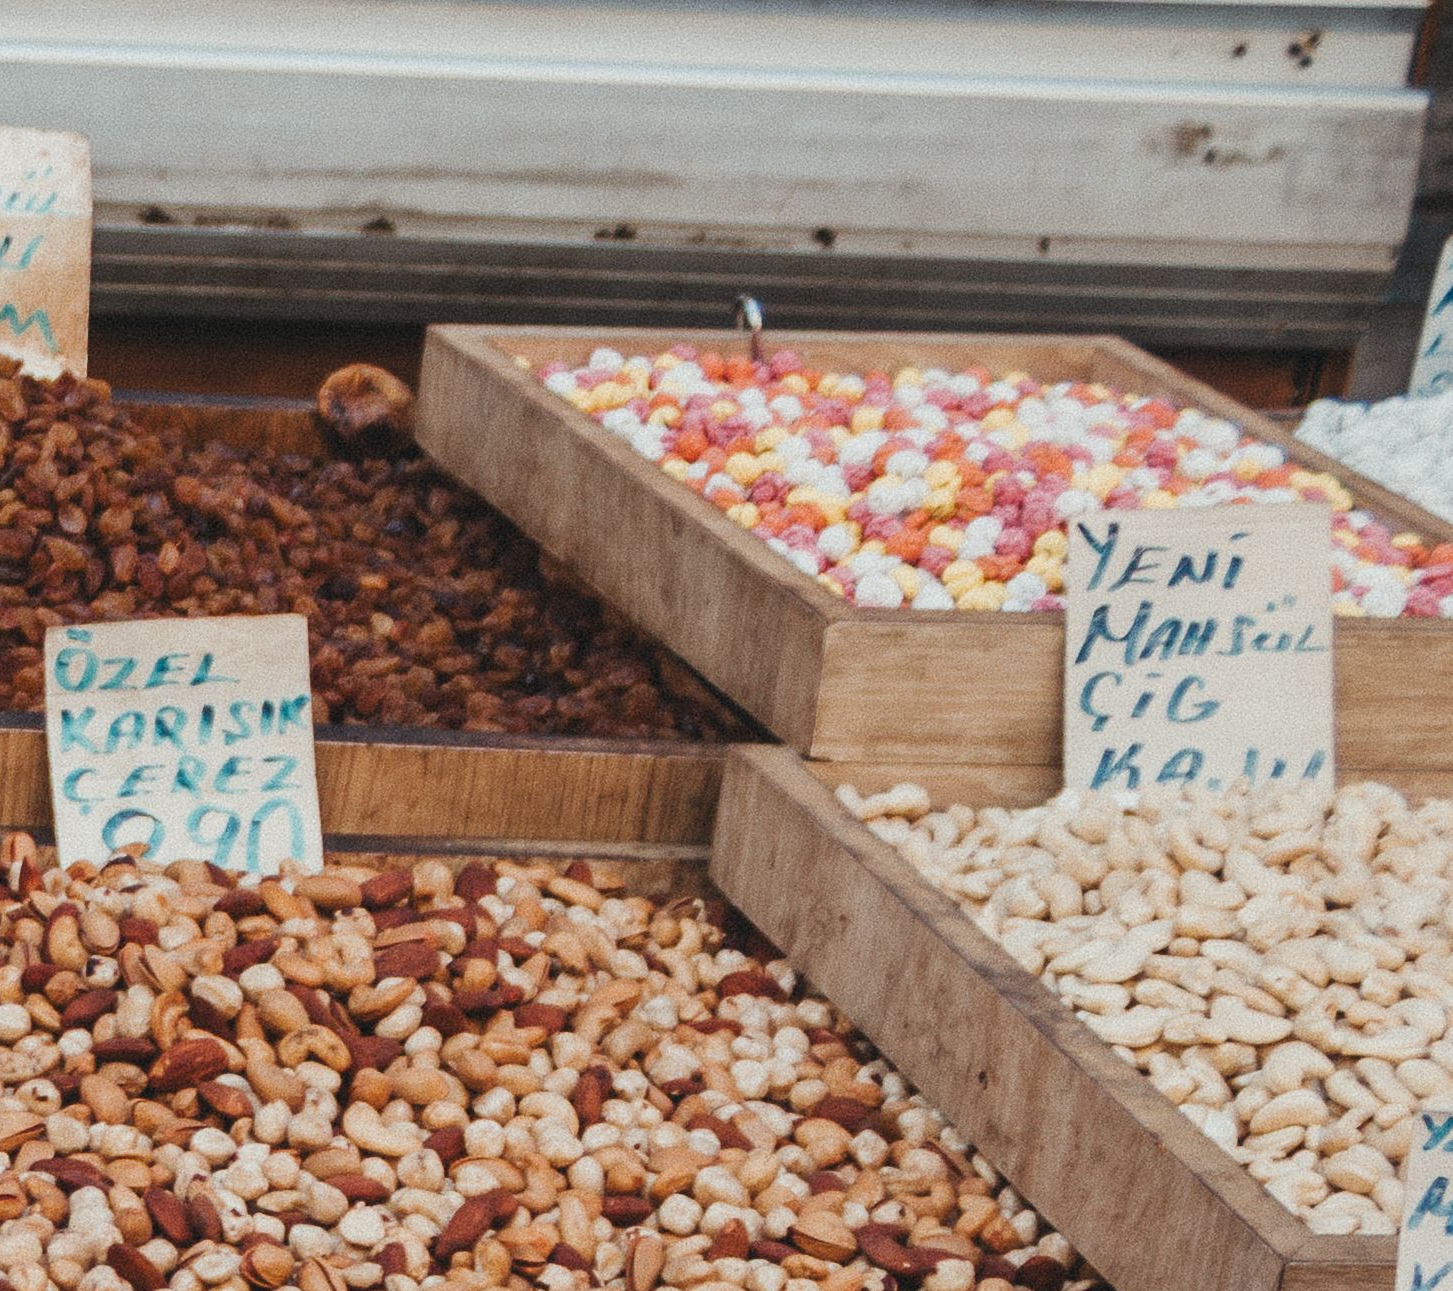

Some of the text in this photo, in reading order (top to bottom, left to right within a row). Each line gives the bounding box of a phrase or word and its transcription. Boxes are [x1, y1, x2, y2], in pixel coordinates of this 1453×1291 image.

[1076, 520, 1251, 592] YENİ
[53, 627, 241, 693] ÖZEL
[1074, 594, 1326, 667] MAHSÜL
[63, 752, 301, 816] ÇEREZ
